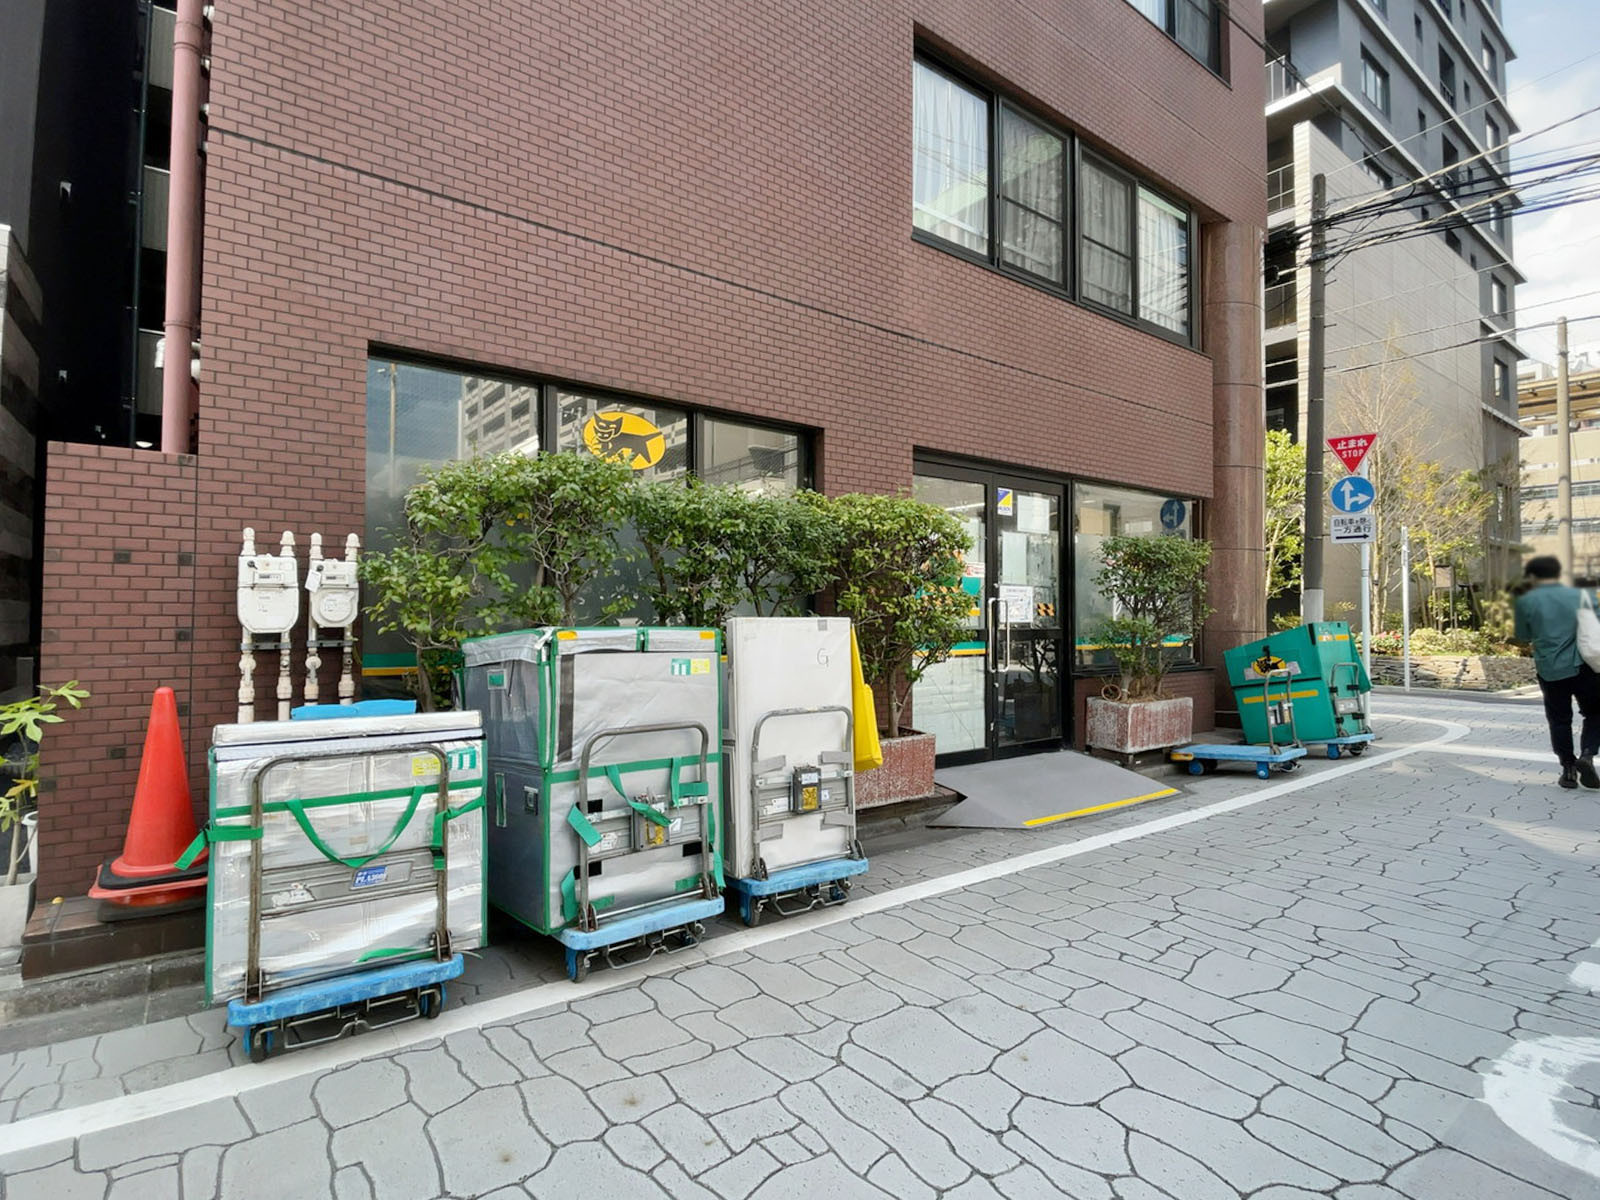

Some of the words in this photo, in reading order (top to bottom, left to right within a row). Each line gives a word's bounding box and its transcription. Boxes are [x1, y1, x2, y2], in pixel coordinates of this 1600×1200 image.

[1336, 438, 1368, 450] 止まれ
[1342, 449, 1364, 458] STOP
[1334, 525, 1371, 534] 一方通行
